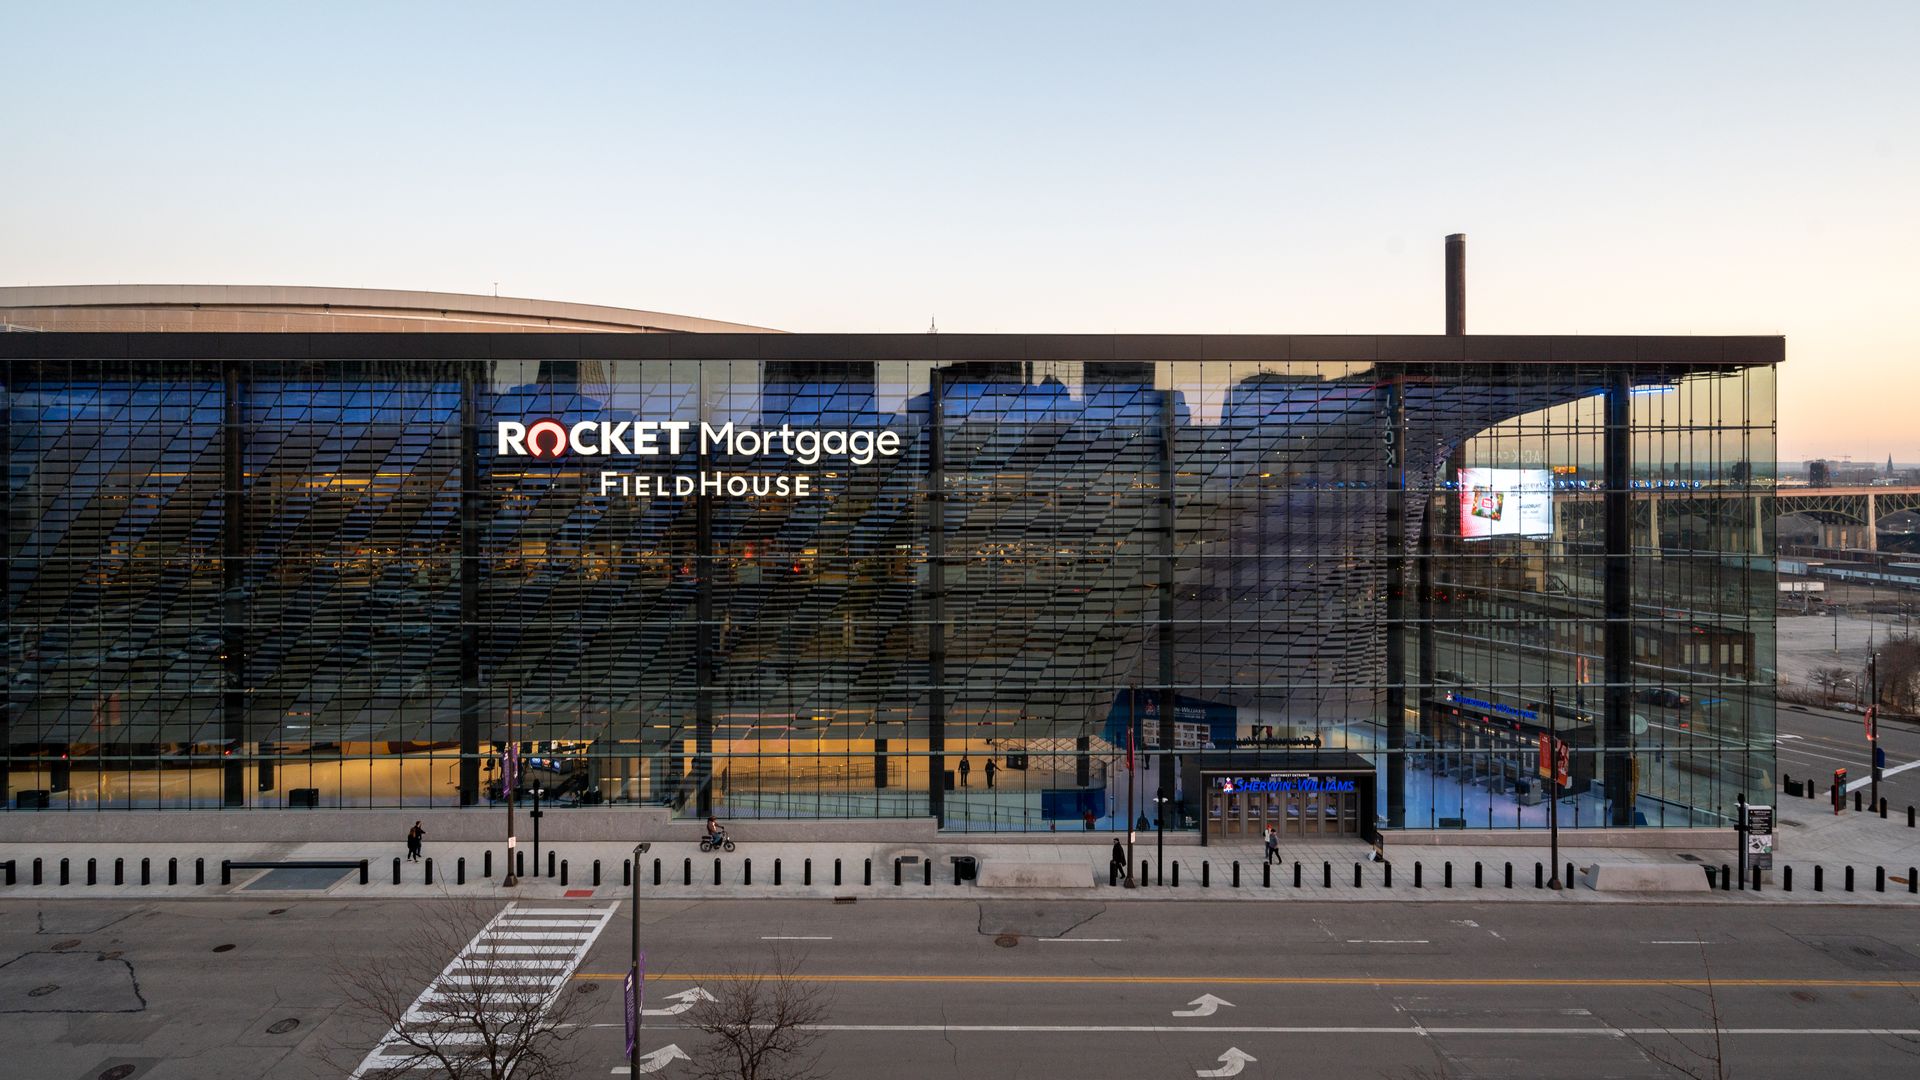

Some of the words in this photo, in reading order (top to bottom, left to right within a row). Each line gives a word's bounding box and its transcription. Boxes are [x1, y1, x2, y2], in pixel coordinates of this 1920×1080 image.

[498, 419, 690, 457] ROCKET
[700, 421, 900, 465] Mortgage
[1235, 778, 1355, 793] SHERWIN-WILLIAMS
